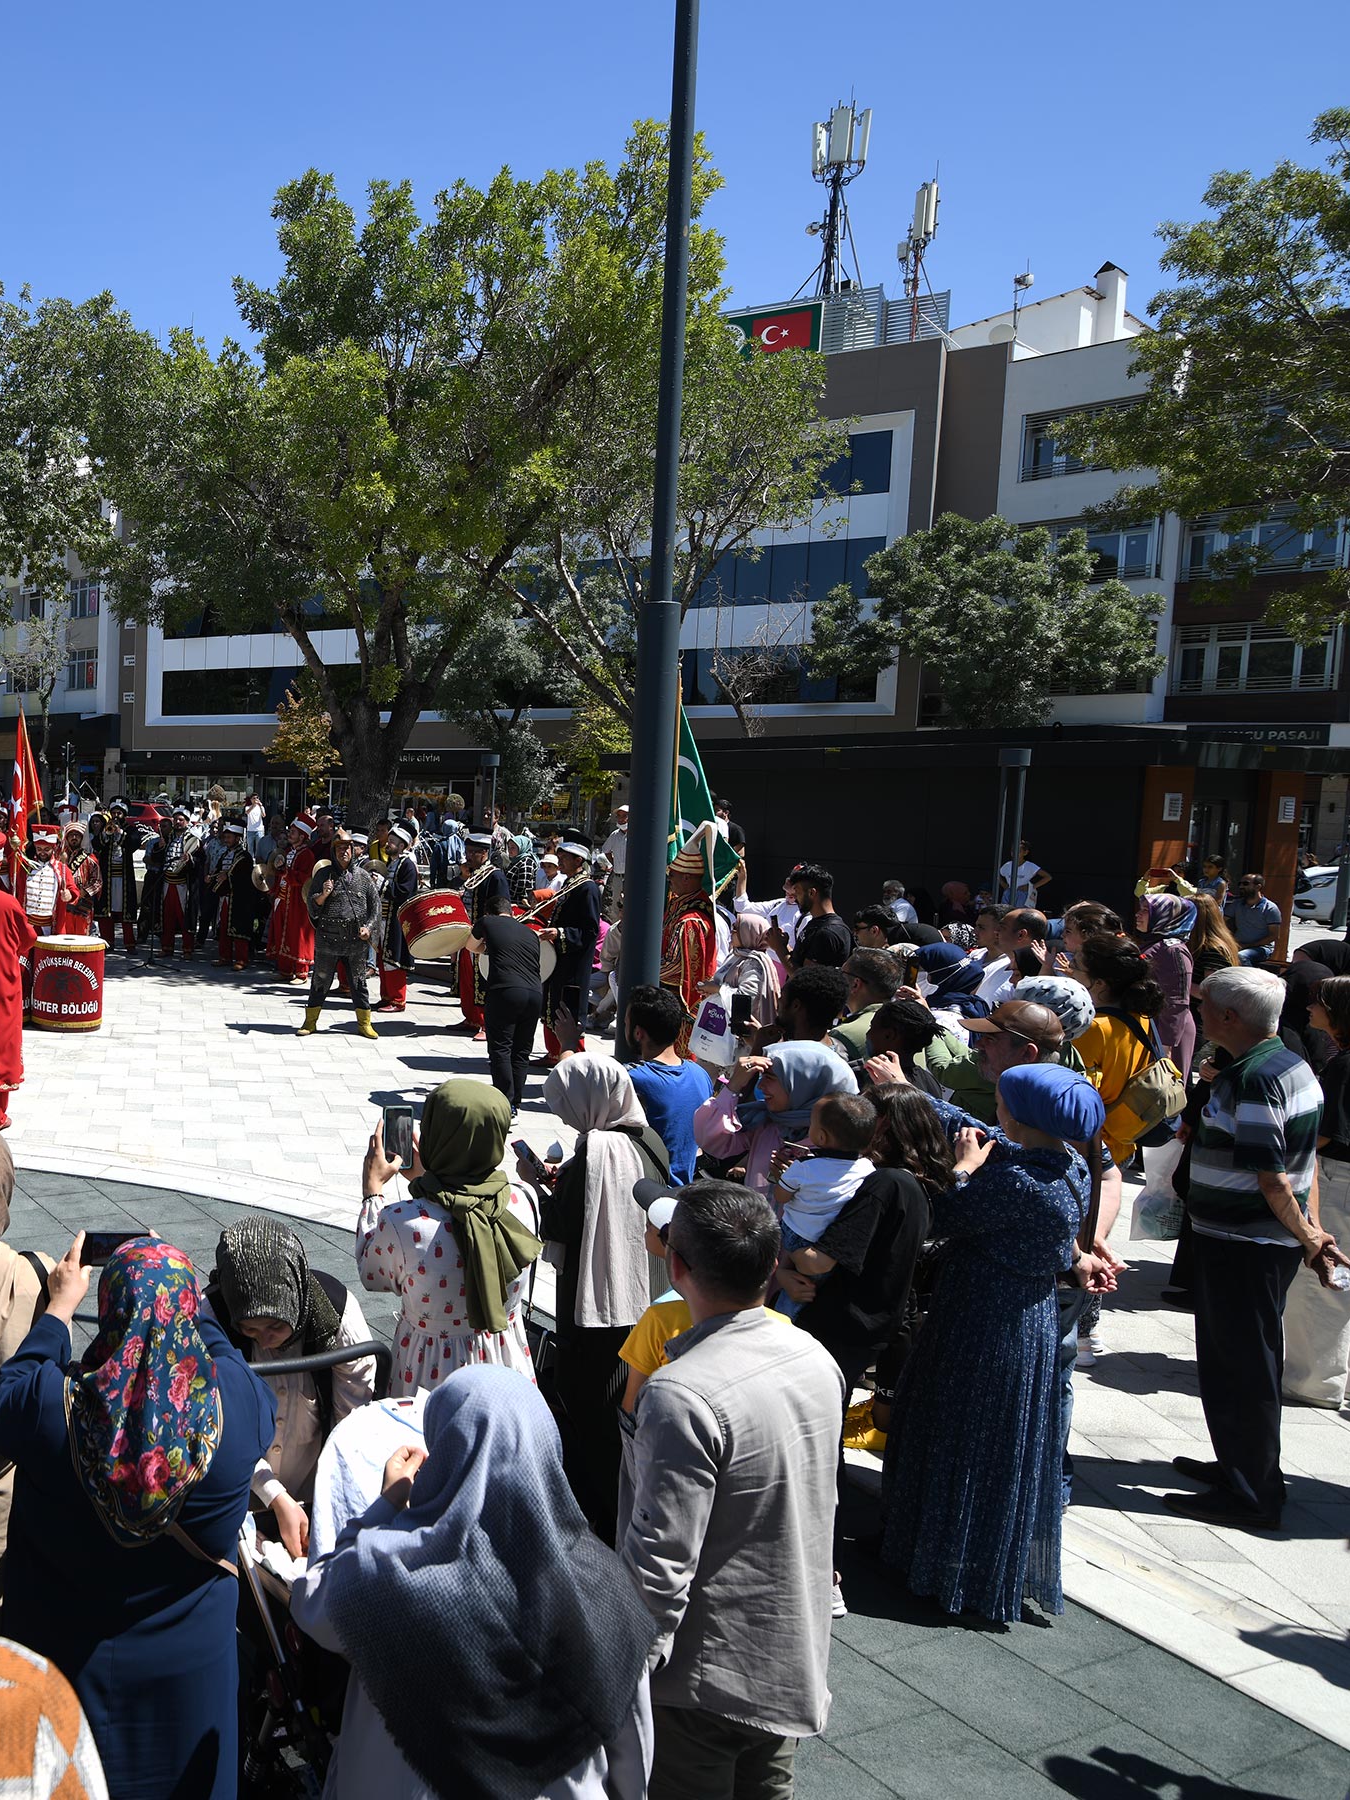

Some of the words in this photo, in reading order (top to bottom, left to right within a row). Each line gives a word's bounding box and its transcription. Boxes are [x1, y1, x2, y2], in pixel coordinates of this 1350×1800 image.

[1267, 730, 1321, 740] PASAJI
[416, 753, 440, 762] GİYİM
[38, 956, 73, 970] BÜYÜKŞEHİR
[32, 999, 58, 1013] EHTER
[61, 1000, 98, 1014] BÖLÜĞÜ
